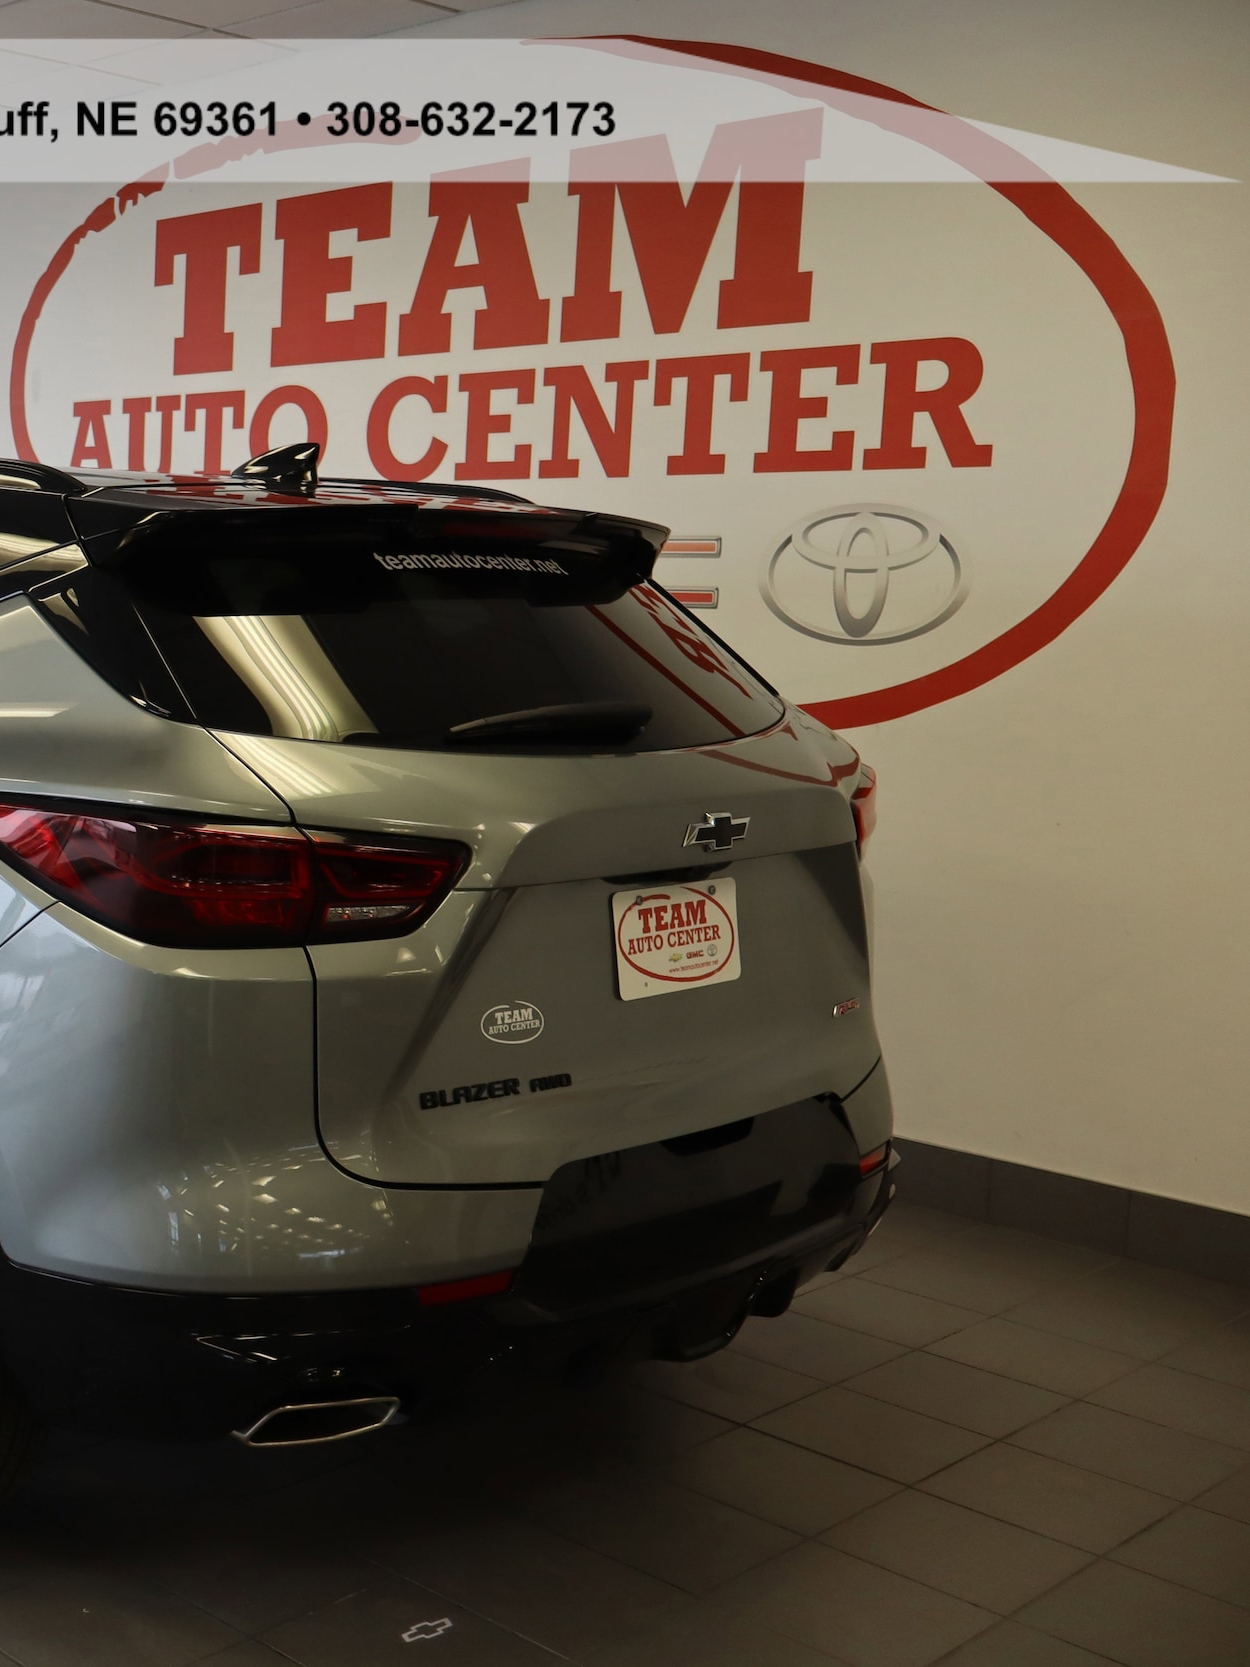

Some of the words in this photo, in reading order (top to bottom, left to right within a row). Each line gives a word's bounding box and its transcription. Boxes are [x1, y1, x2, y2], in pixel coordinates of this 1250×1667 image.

[154, 107, 824, 376] TEAM
[71, 384, 329, 474] AUTO
[366, 336, 994, 482] CENTER
[373, 552, 569, 575] teamautocenter.net
[638, 899, 707, 935] TEAM
[627, 935, 664, 956] AUTO
[667, 924, 721, 948] CENTER
[686, 950, 705, 959] GMC
[488, 1024, 510, 1035] AUTO
[510, 1020, 541, 1032] CENTER
[494, 1008, 534, 1025] TEAM
[419, 1078, 520, 1110] BLAZER
[529, 1073, 572, 1093] AWD
